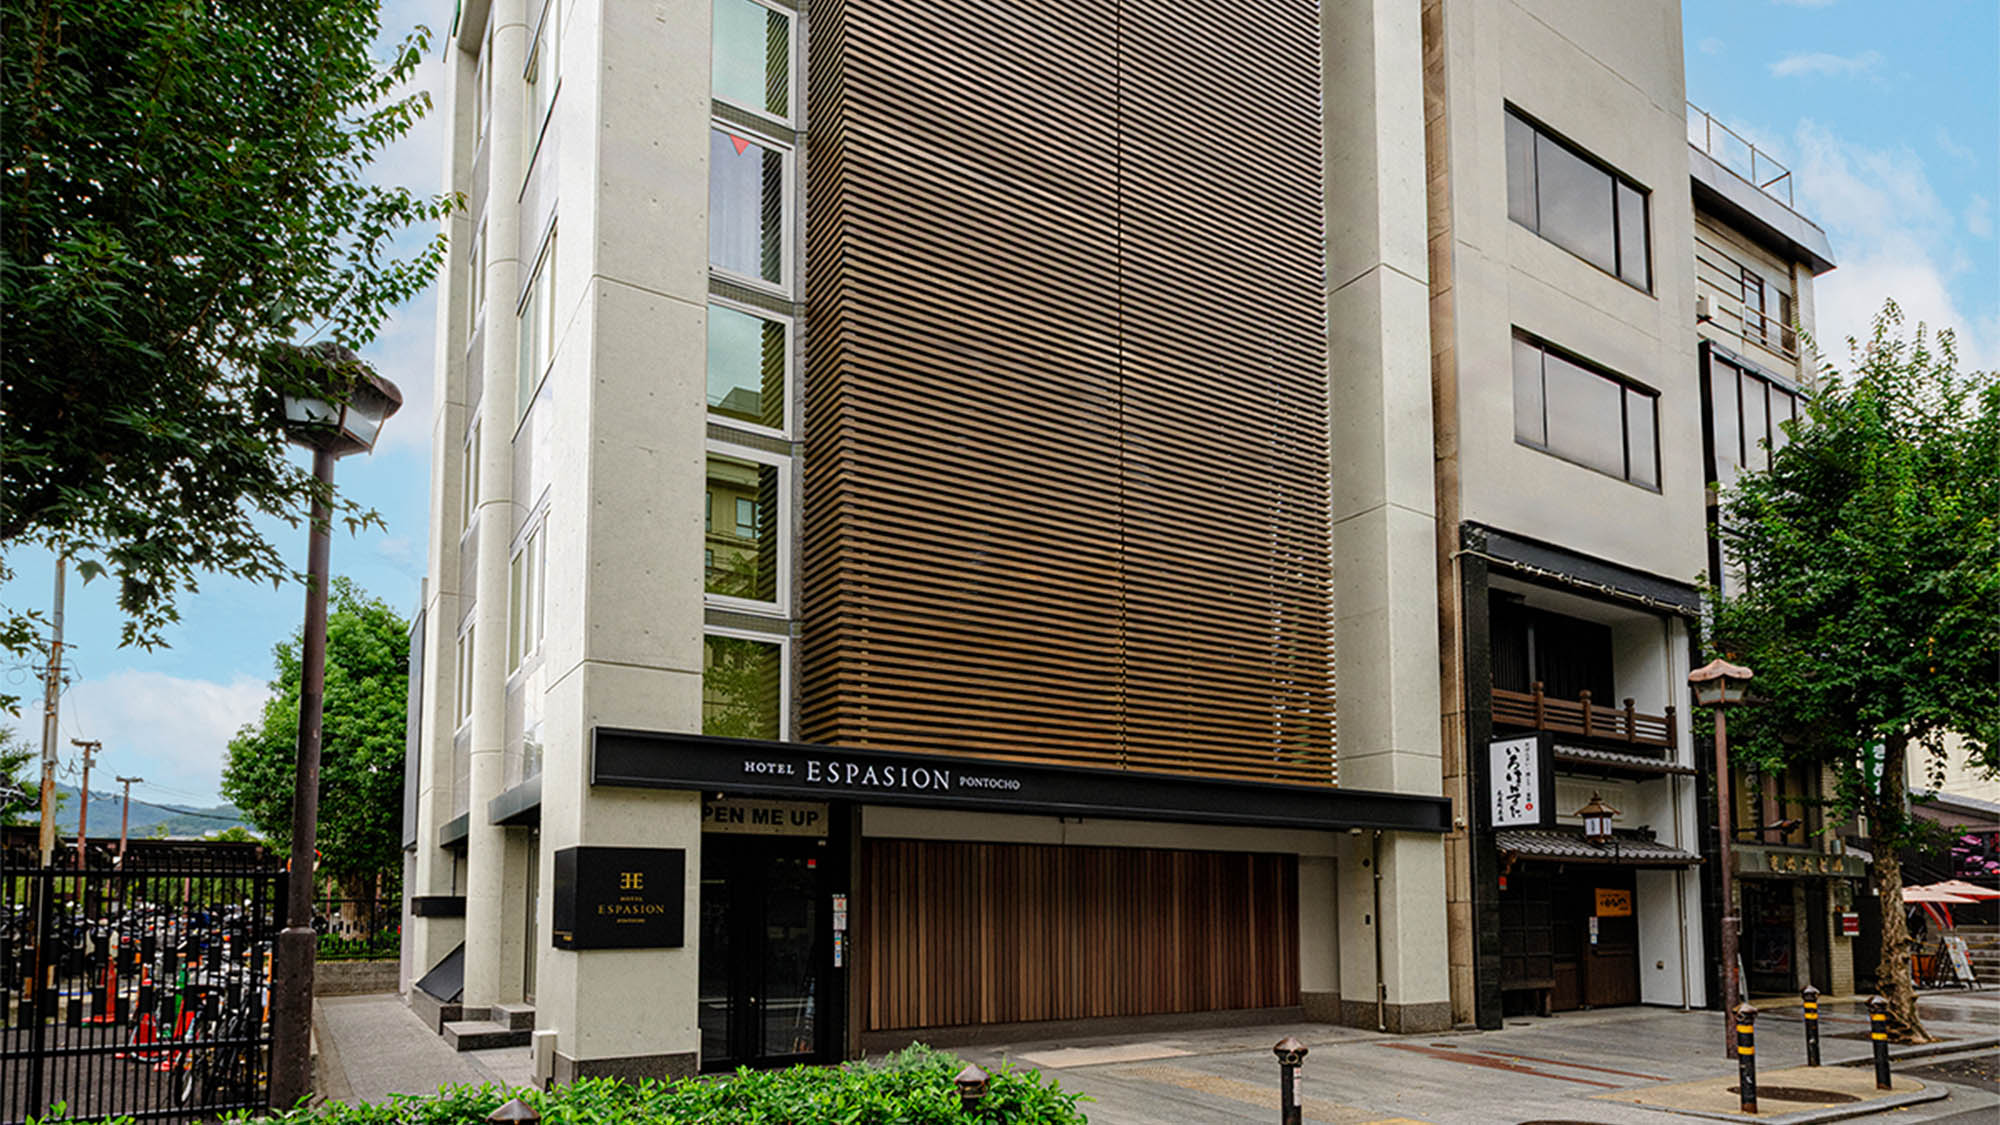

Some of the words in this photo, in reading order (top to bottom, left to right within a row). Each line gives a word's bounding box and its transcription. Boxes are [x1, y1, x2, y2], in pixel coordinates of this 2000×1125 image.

[744, 761, 795, 775] HOTEL
[807, 760, 950, 790] ESPASION
[959, 776, 1021, 790] PONTOCHO
[752, 808, 784, 825] ME
[791, 810, 818, 826] UP
[598, 904, 664, 914] ESPASION
